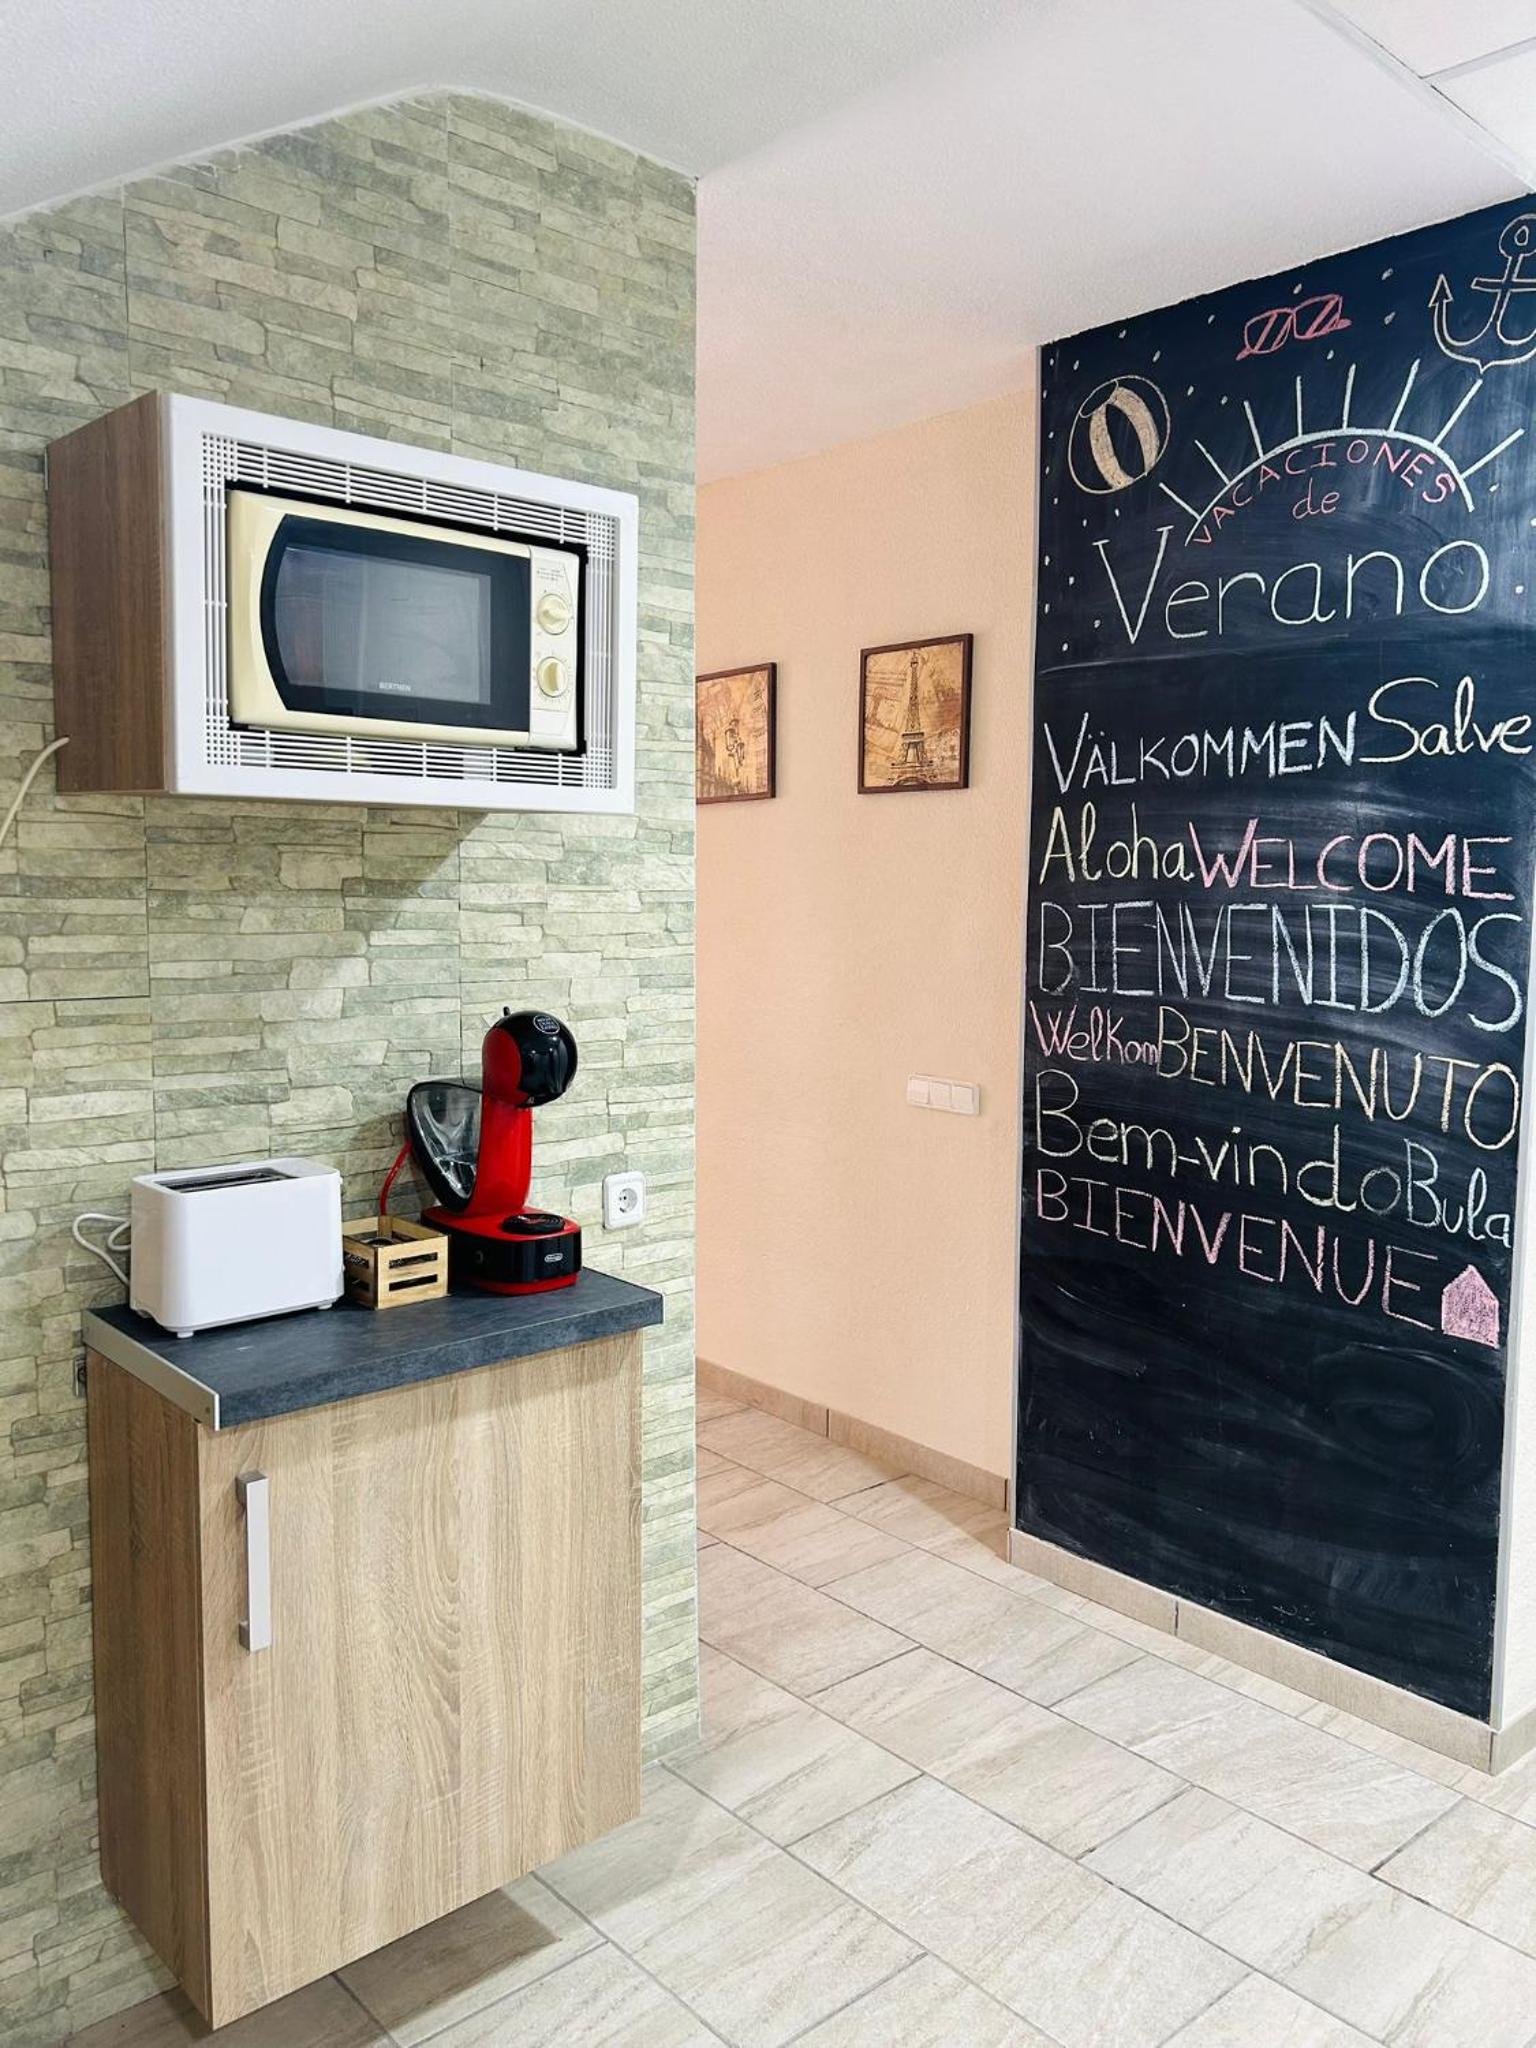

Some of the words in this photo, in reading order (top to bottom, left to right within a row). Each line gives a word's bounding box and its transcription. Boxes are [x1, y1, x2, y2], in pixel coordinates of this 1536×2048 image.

[1193, 439, 1457, 545] VACACIONES
[1292, 478, 1340, 520] de
[1092, 525, 1491, 645] Verano
[1358, 675, 1533, 763] Salve
[1039, 802, 1194, 885] Aloha
[1188, 818, 1515, 901] WELCOME
[1038, 900, 1523, 1033] BIENVENIDOS
[1156, 1005, 1520, 1150] BENVENUTO
[1035, 1068, 1401, 1215] Bem-vindo
[1402, 1137, 1511, 1248] Bula
[1036, 1168, 1439, 1331] BIENVENUE
